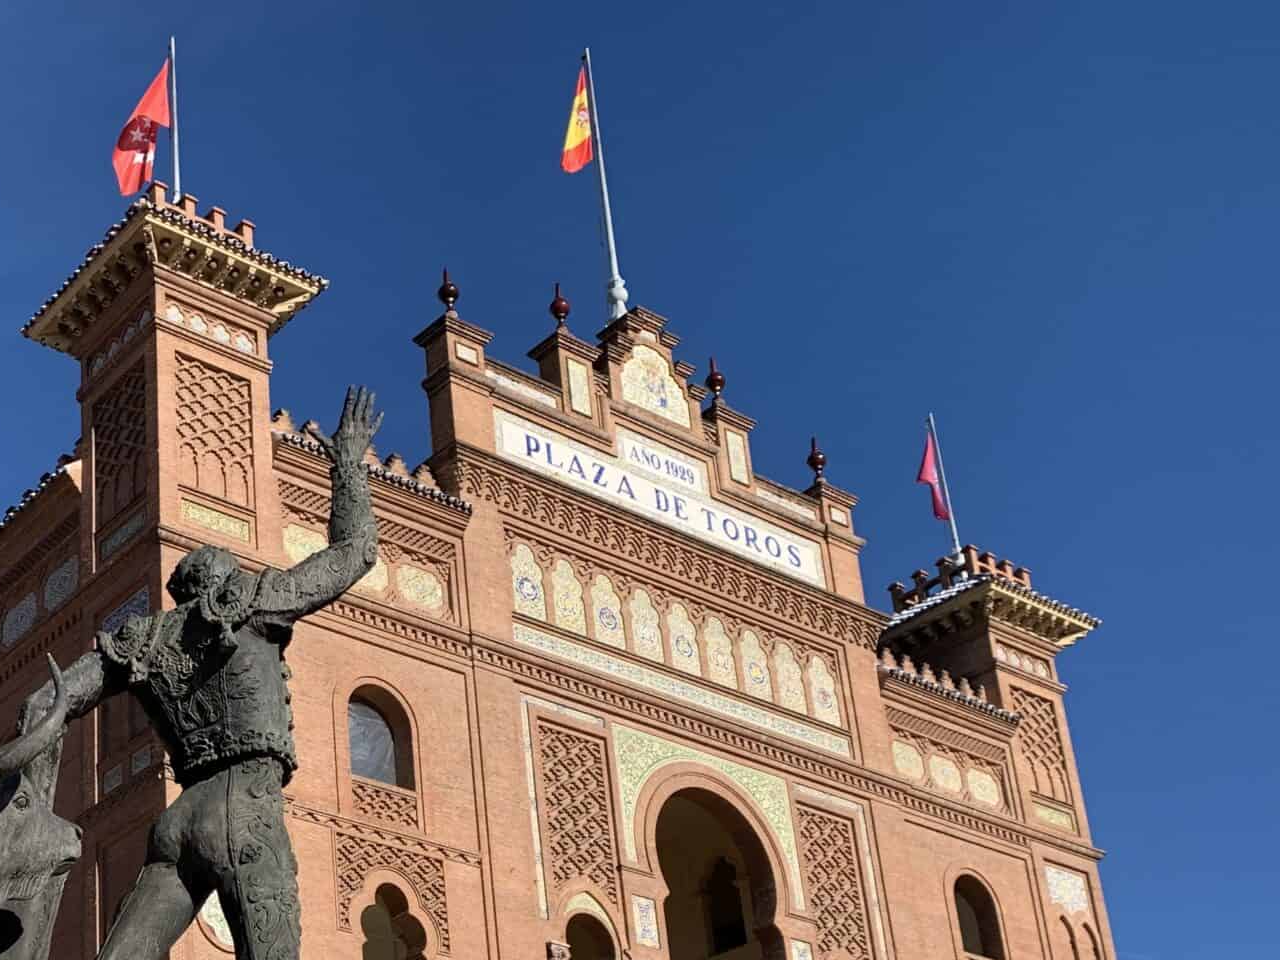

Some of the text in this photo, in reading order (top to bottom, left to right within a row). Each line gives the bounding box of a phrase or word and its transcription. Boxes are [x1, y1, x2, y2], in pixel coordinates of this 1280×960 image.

[525, 433, 801, 568] PLAZA DE TOROS
[664, 459, 695, 485] 1929
